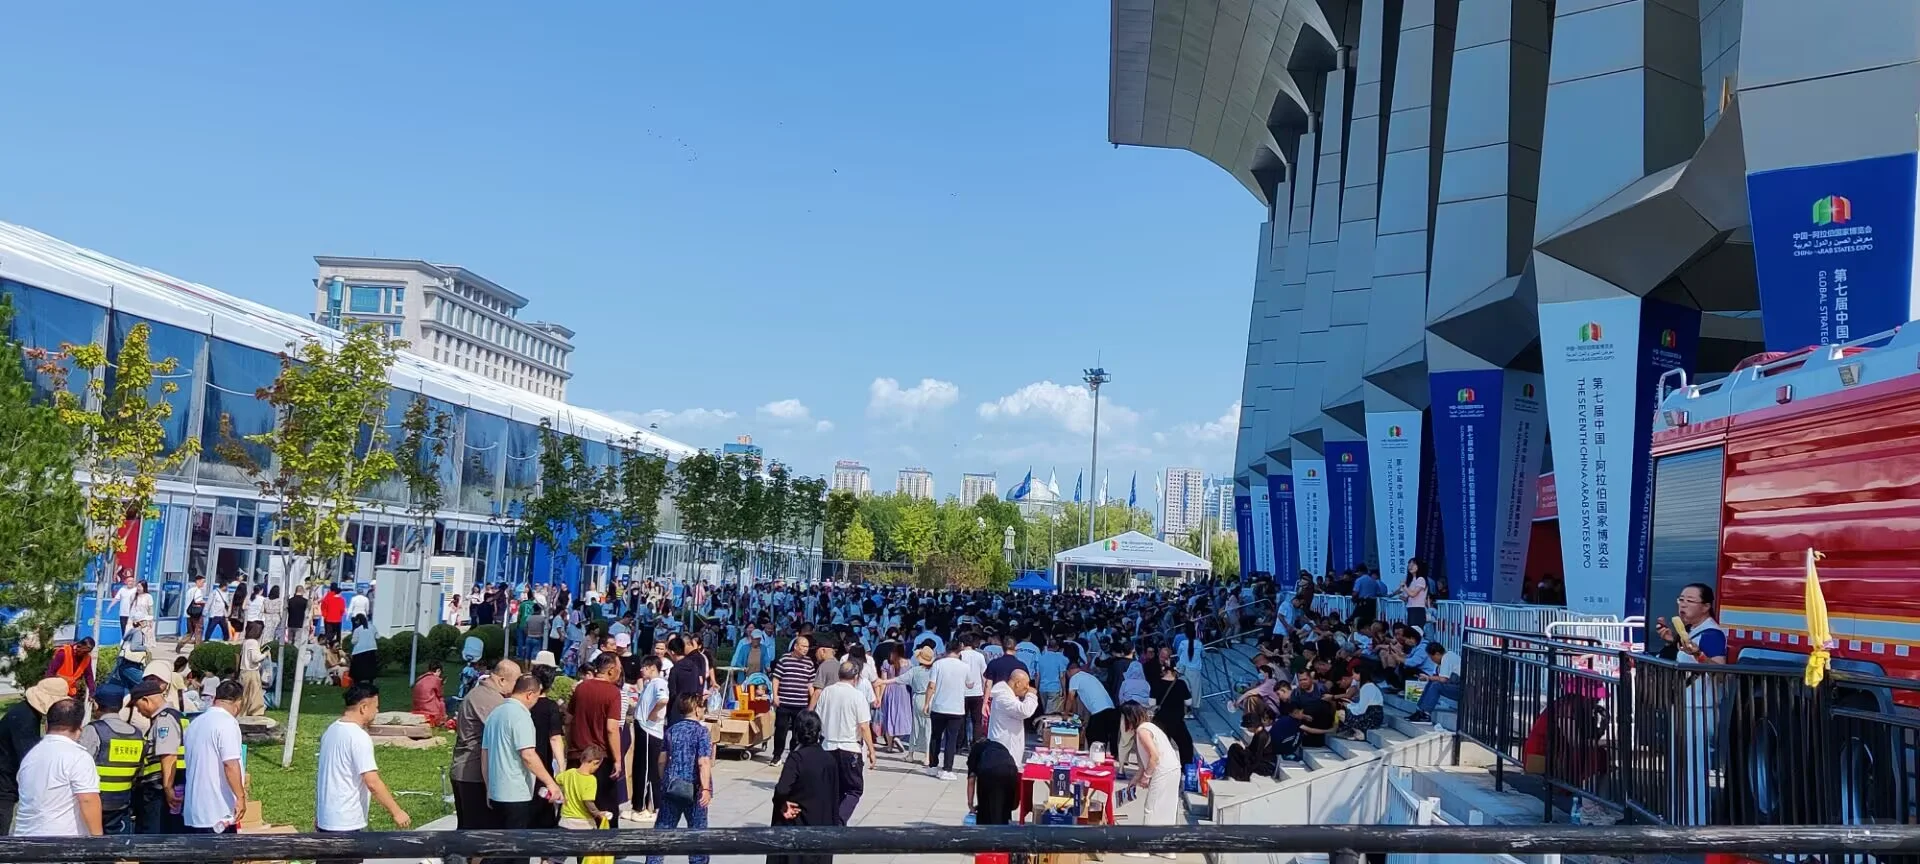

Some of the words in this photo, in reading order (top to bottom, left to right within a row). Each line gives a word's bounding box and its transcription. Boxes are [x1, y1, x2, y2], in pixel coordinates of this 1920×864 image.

[1818, 270, 1828, 304] GLOBAL
[1577, 377, 1586, 396] THE
[1578, 397, 1588, 445] SEVENTH
[1582, 509, 1591, 542] STATES
[1583, 543, 1592, 569] EXPO
